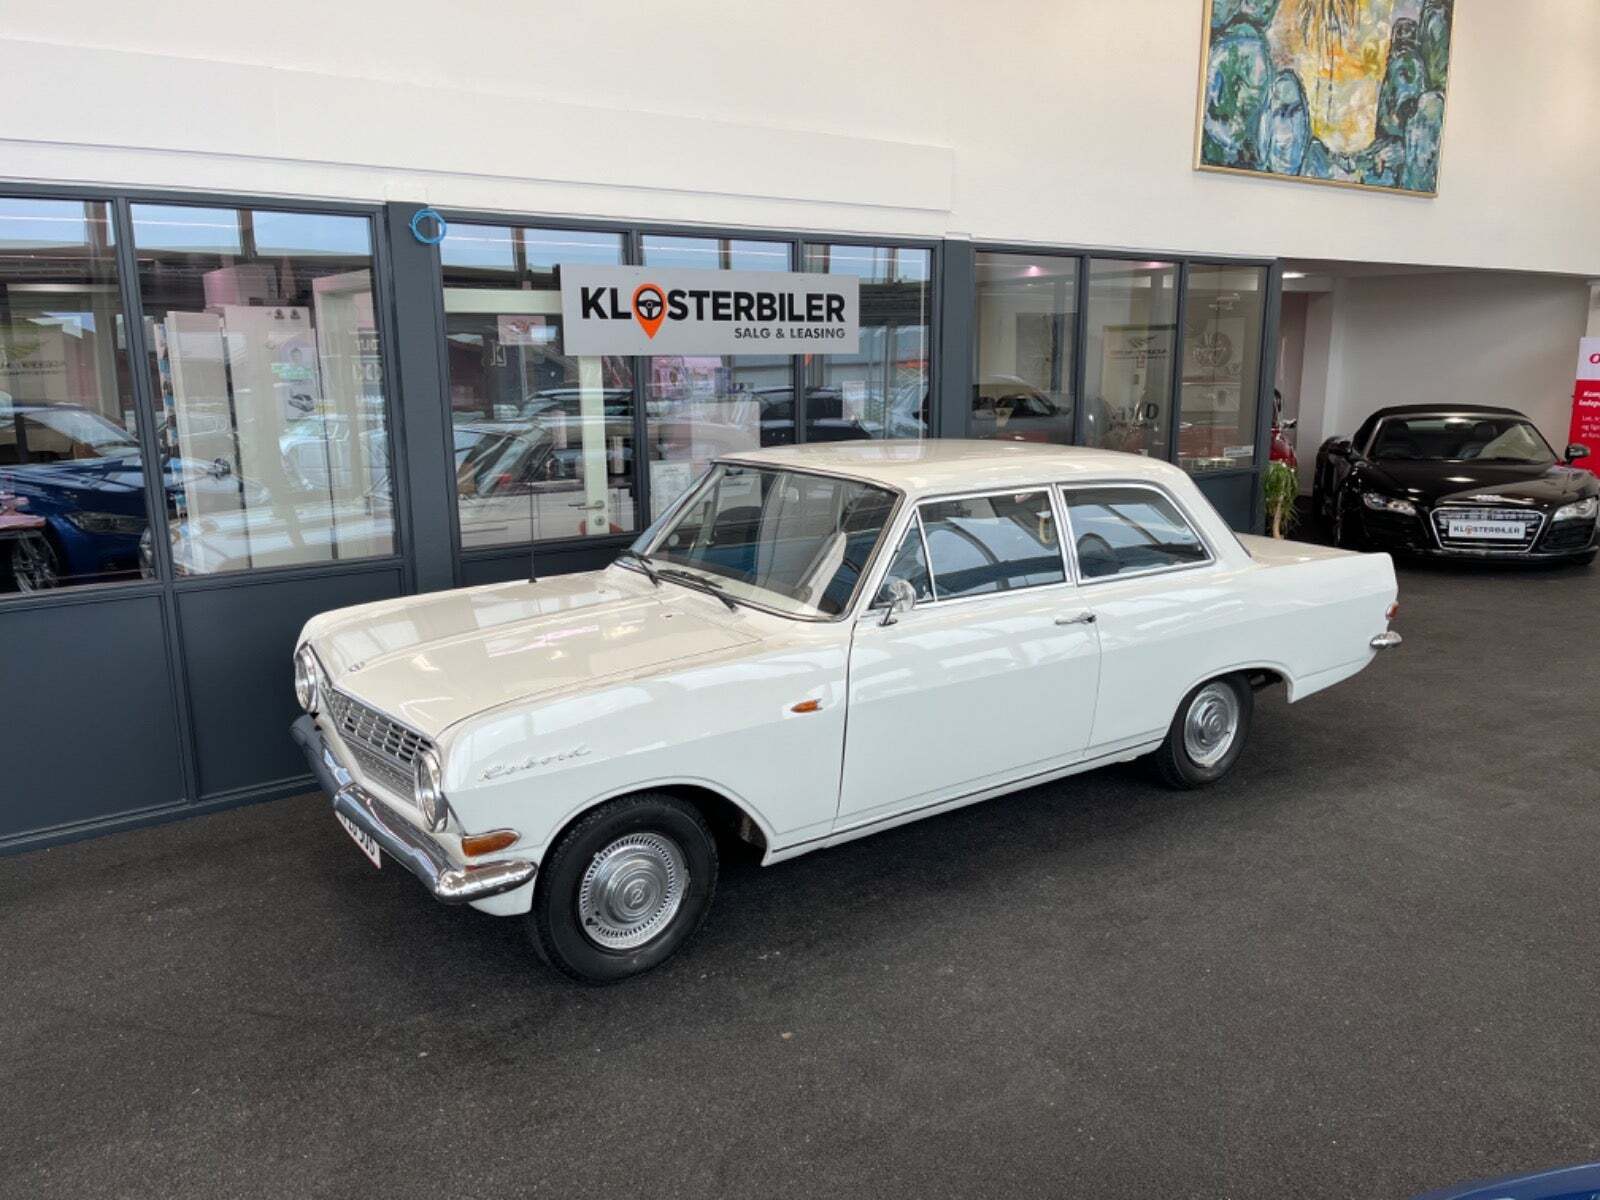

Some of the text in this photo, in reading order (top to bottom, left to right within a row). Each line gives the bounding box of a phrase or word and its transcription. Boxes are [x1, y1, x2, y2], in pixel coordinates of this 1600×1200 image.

[580, 285, 846, 325] KLOSTERBILER
[734, 327, 845, 339] SALG & LEASING
